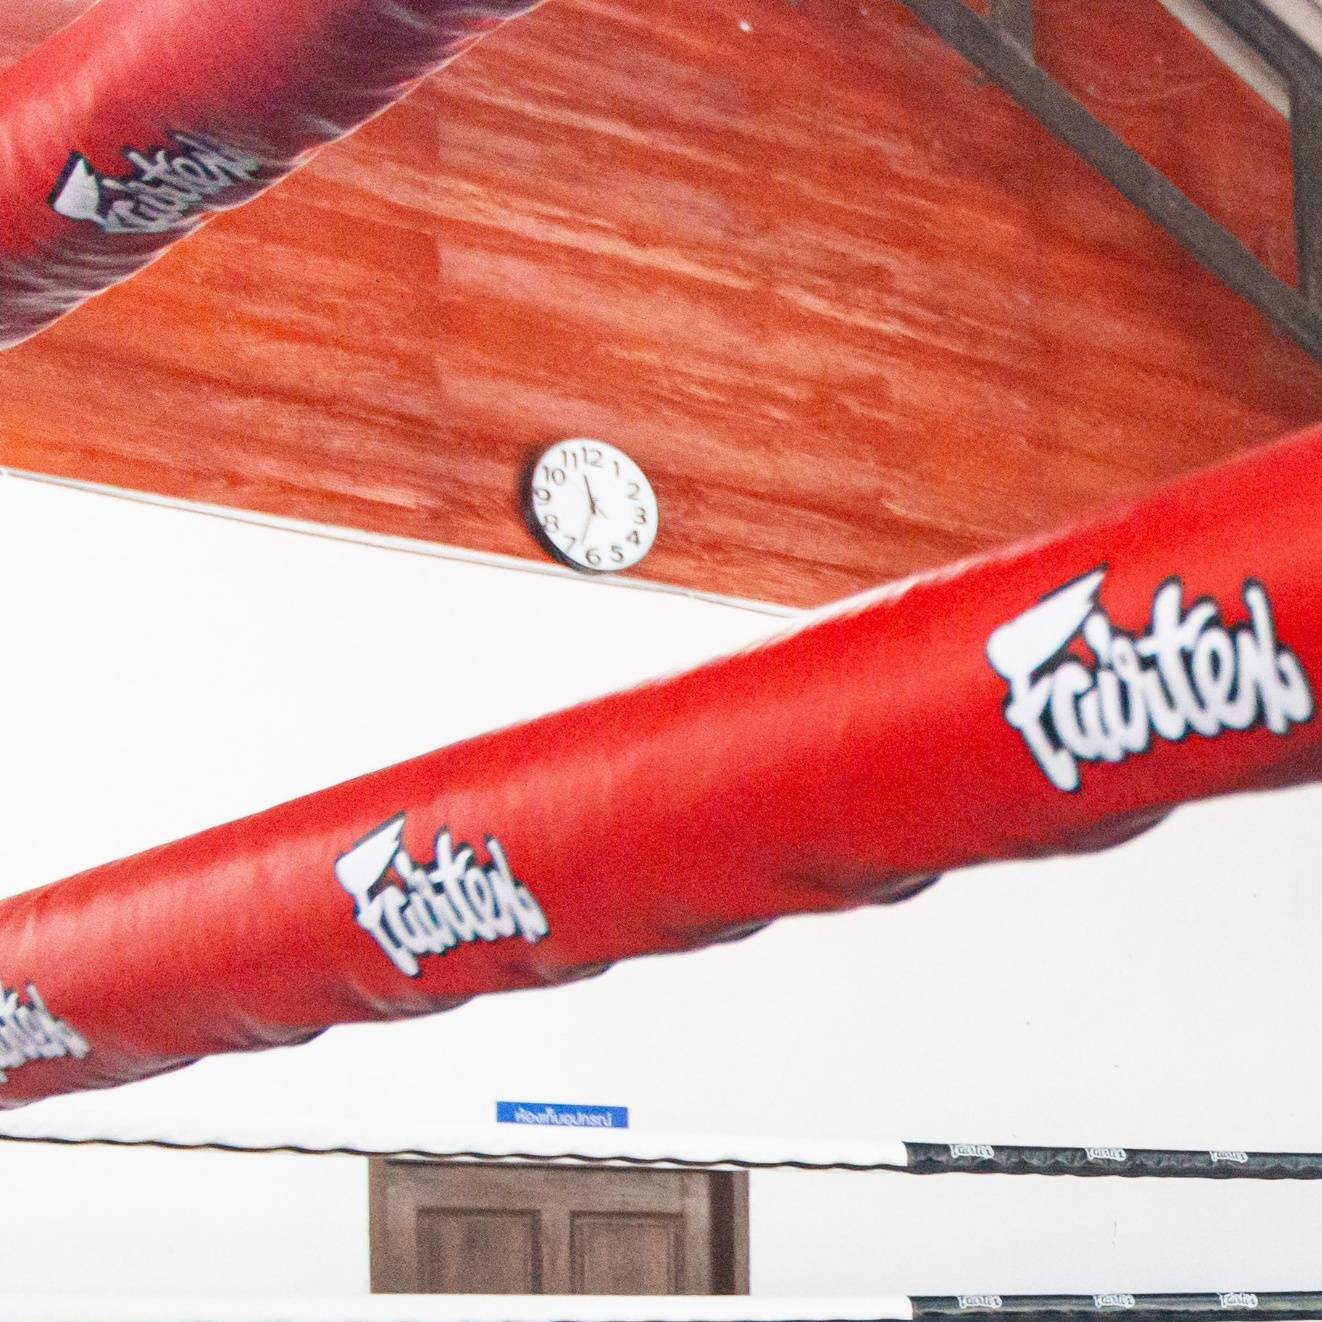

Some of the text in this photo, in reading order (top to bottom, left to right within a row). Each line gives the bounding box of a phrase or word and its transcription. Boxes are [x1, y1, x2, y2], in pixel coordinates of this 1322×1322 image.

[562, 449, 577, 469] 11
[582, 447, 602, 468] 12
[543, 465, 566, 485] 10
[613, 461, 620, 477] 1
[534, 488, 551, 505] 9
[627, 482, 640, 501] 2
[543, 514, 559, 533] 8
[634, 507, 646, 524] 3
[564, 535, 577, 553] 7
[626, 530, 640, 545] 4
[585, 548, 601, 565] 6
[610, 545, 624, 563] 5
[987, 565, 1314, 791] Fairtex
[335, 811, 548, 976] Fairtex
